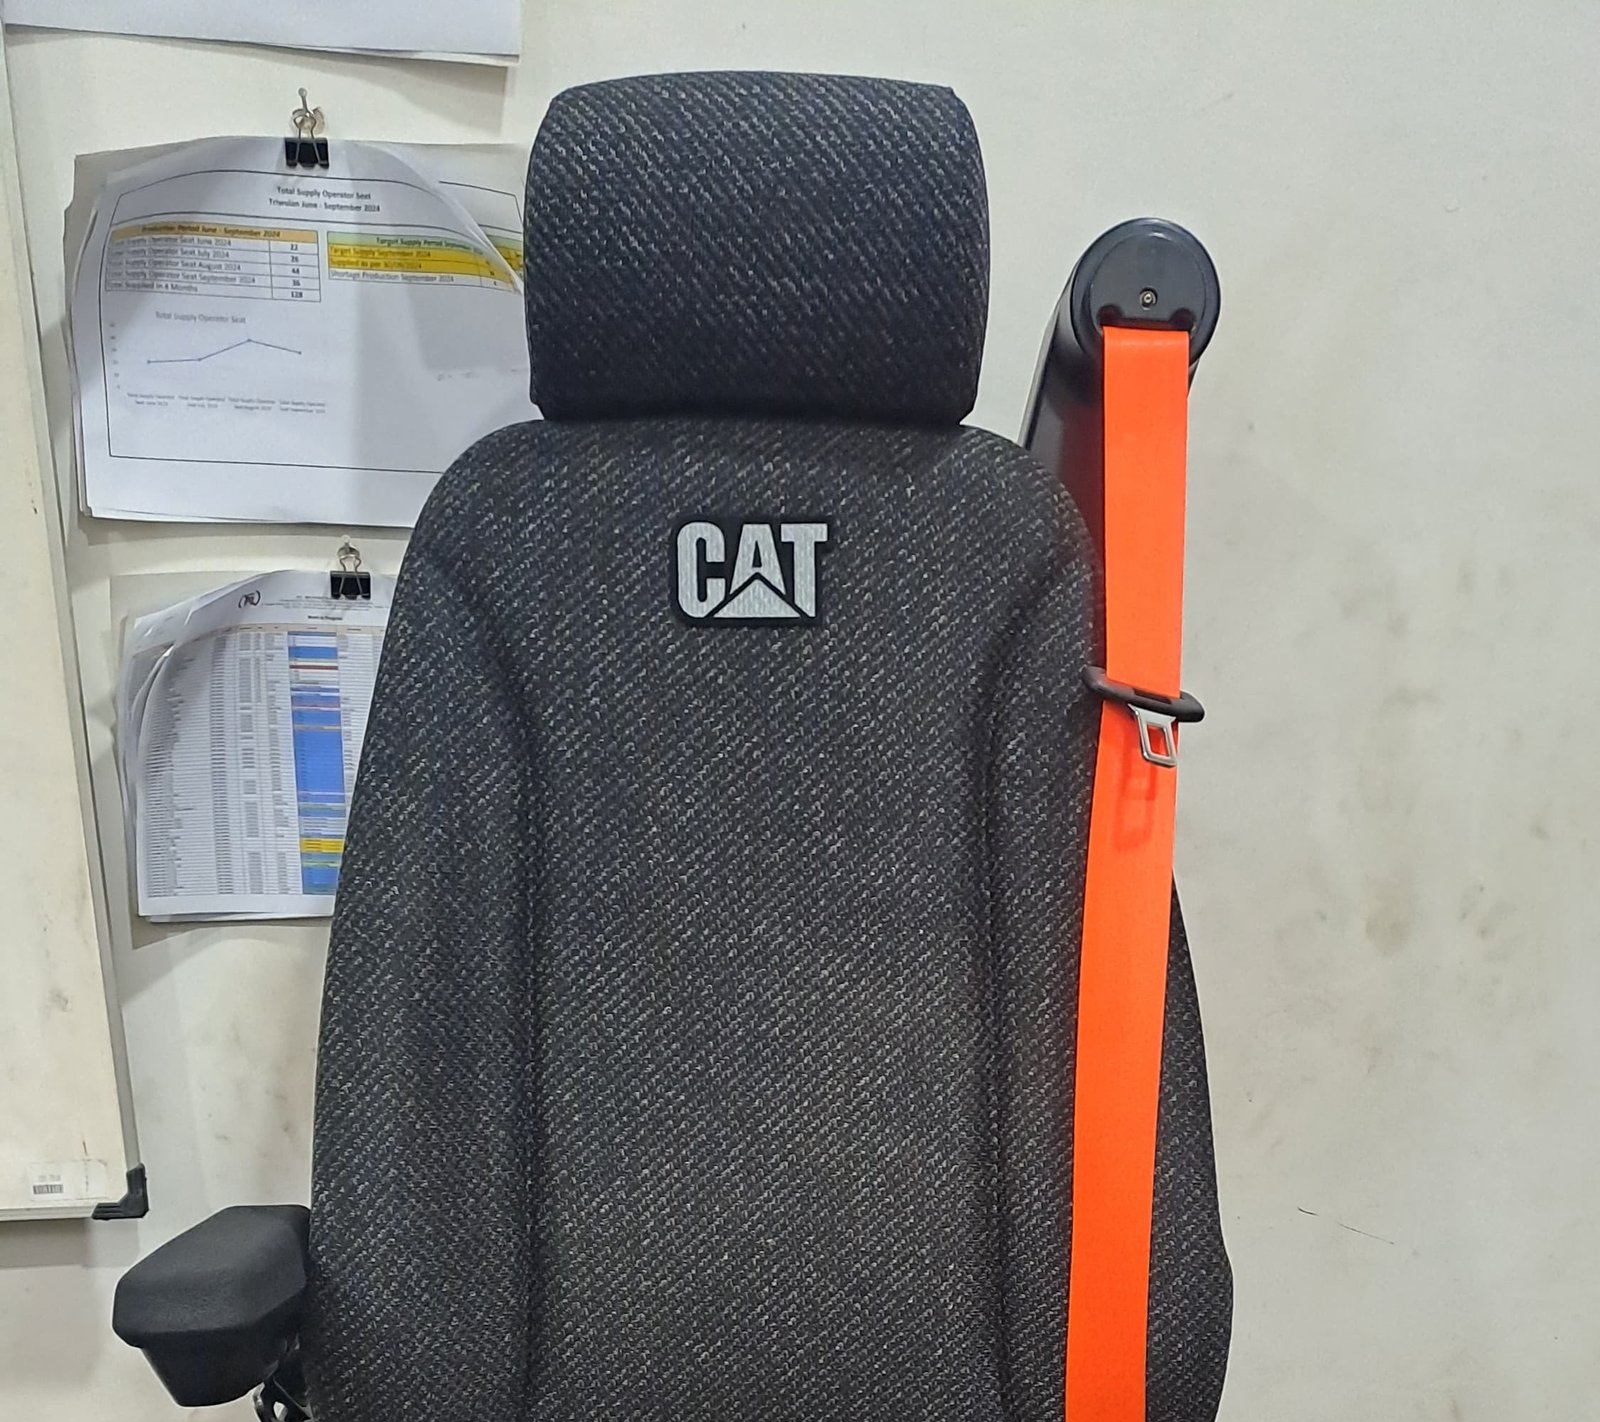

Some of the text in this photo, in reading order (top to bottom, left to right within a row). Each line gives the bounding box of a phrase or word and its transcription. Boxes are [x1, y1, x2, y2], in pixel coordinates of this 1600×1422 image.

[277, 186, 371, 200] Total Supply Operator Seat
[301, 199, 318, 208] June
[324, 202, 362, 212] September
[201, 225, 217, 233] June
[224, 227, 261, 236] September
[263, 230, 281, 238] 2024
[376, 237, 398, 247] Target
[199, 273, 237, 283] September
[677, 521, 828, 618] CAT
